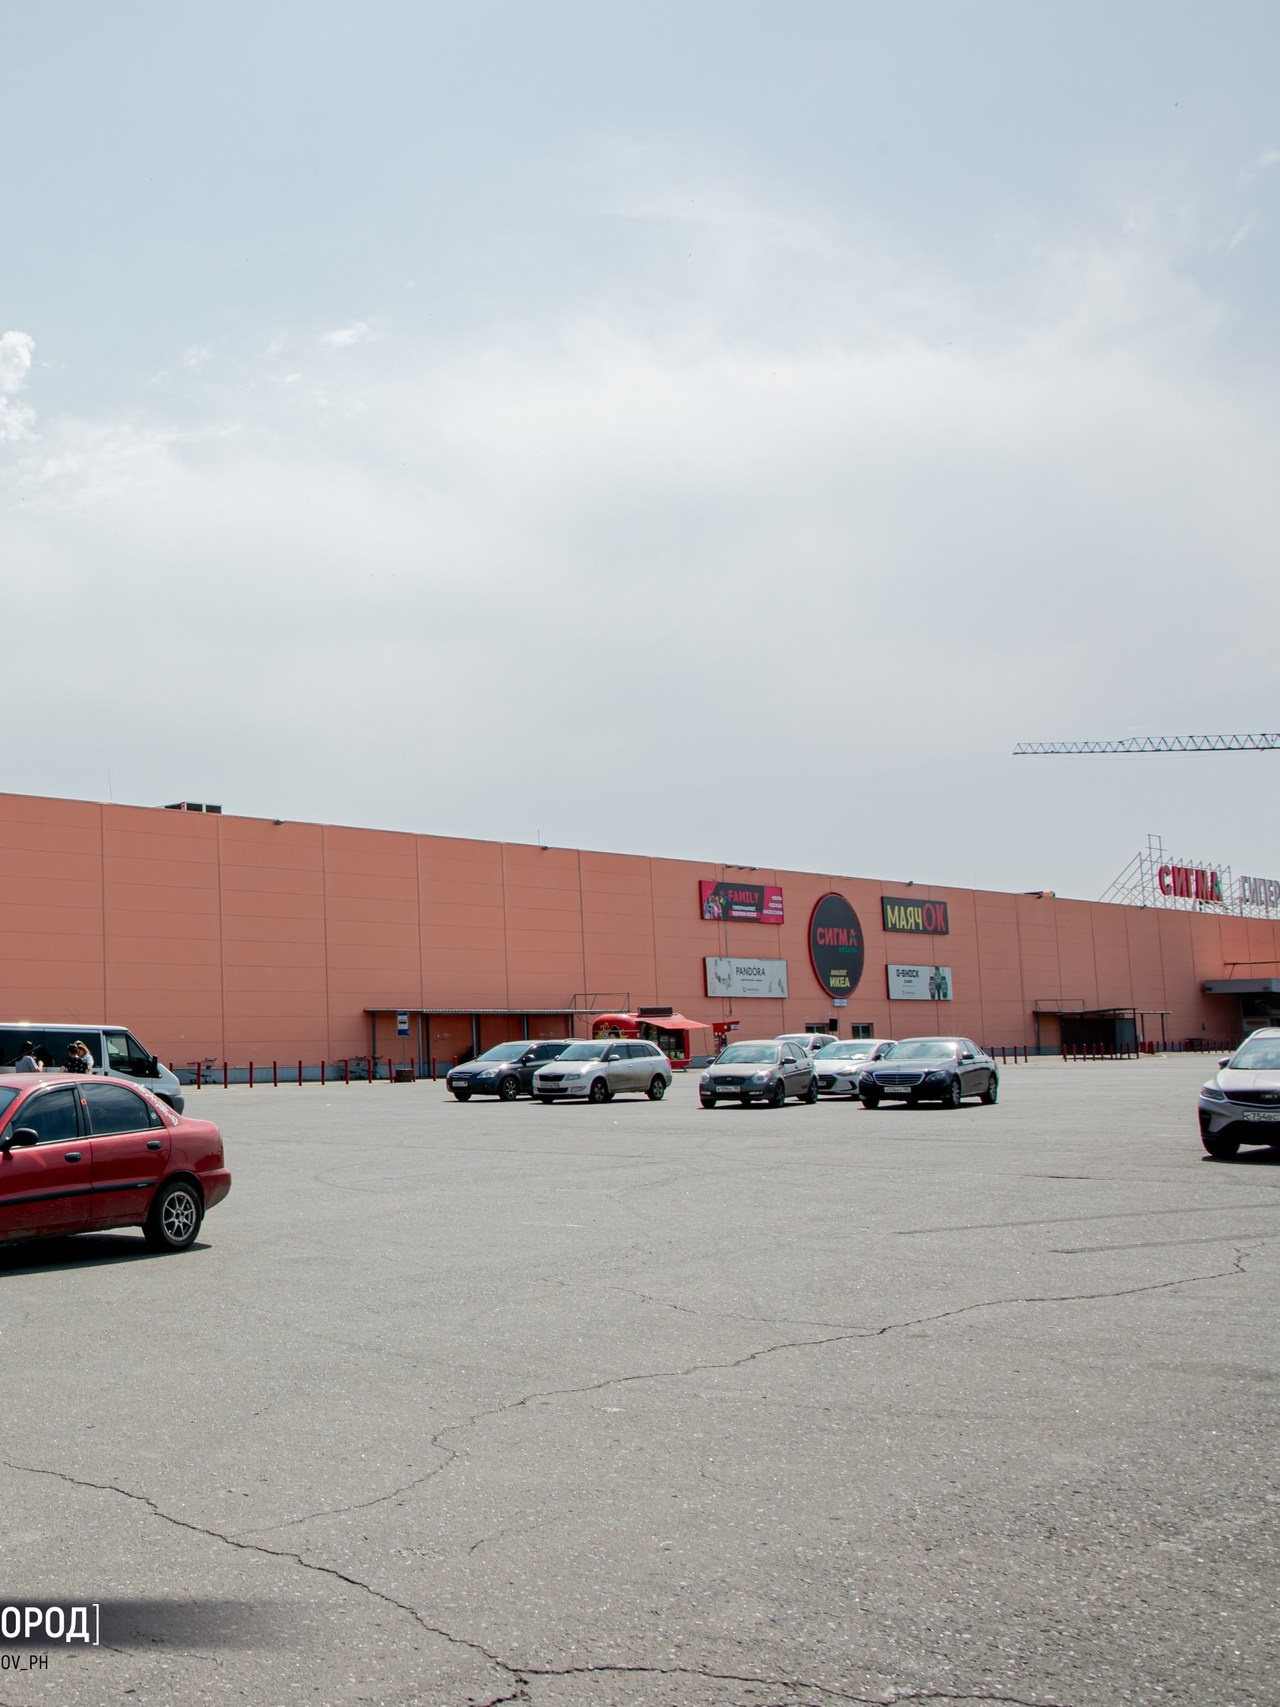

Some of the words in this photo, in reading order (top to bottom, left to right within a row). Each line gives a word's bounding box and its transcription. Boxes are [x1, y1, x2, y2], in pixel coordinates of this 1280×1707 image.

[1158, 864, 1223, 902] СИГМА
[728, 889, 760, 905] FAMILY
[886, 903, 946, 931] МАЯЧОК
[816, 927, 858, 946] СИГМА
[829, 976, 851, 988] ИКЕА
